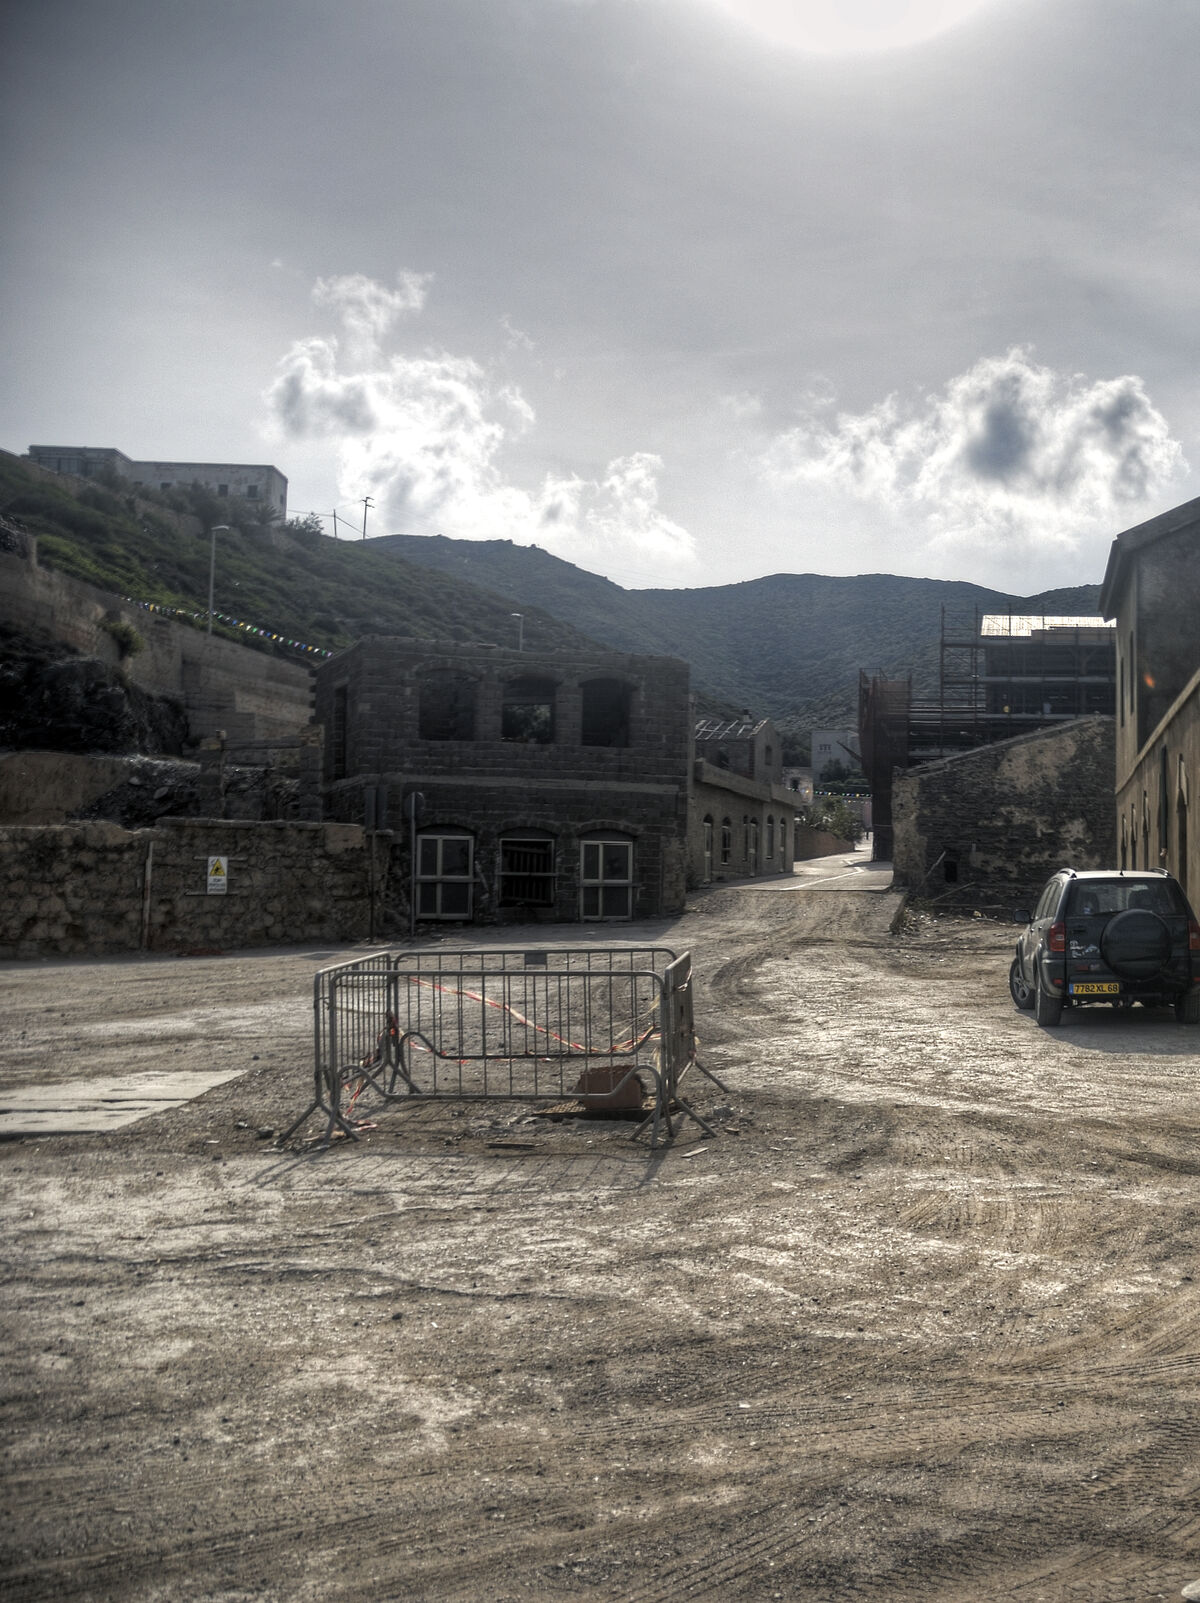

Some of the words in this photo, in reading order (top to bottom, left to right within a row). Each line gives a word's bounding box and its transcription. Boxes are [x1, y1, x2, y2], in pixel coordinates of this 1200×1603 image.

[1074, 984, 1095, 993] 7782
[1096, 984, 1107, 993] XL
[1107, 984, 1118, 993] 68
